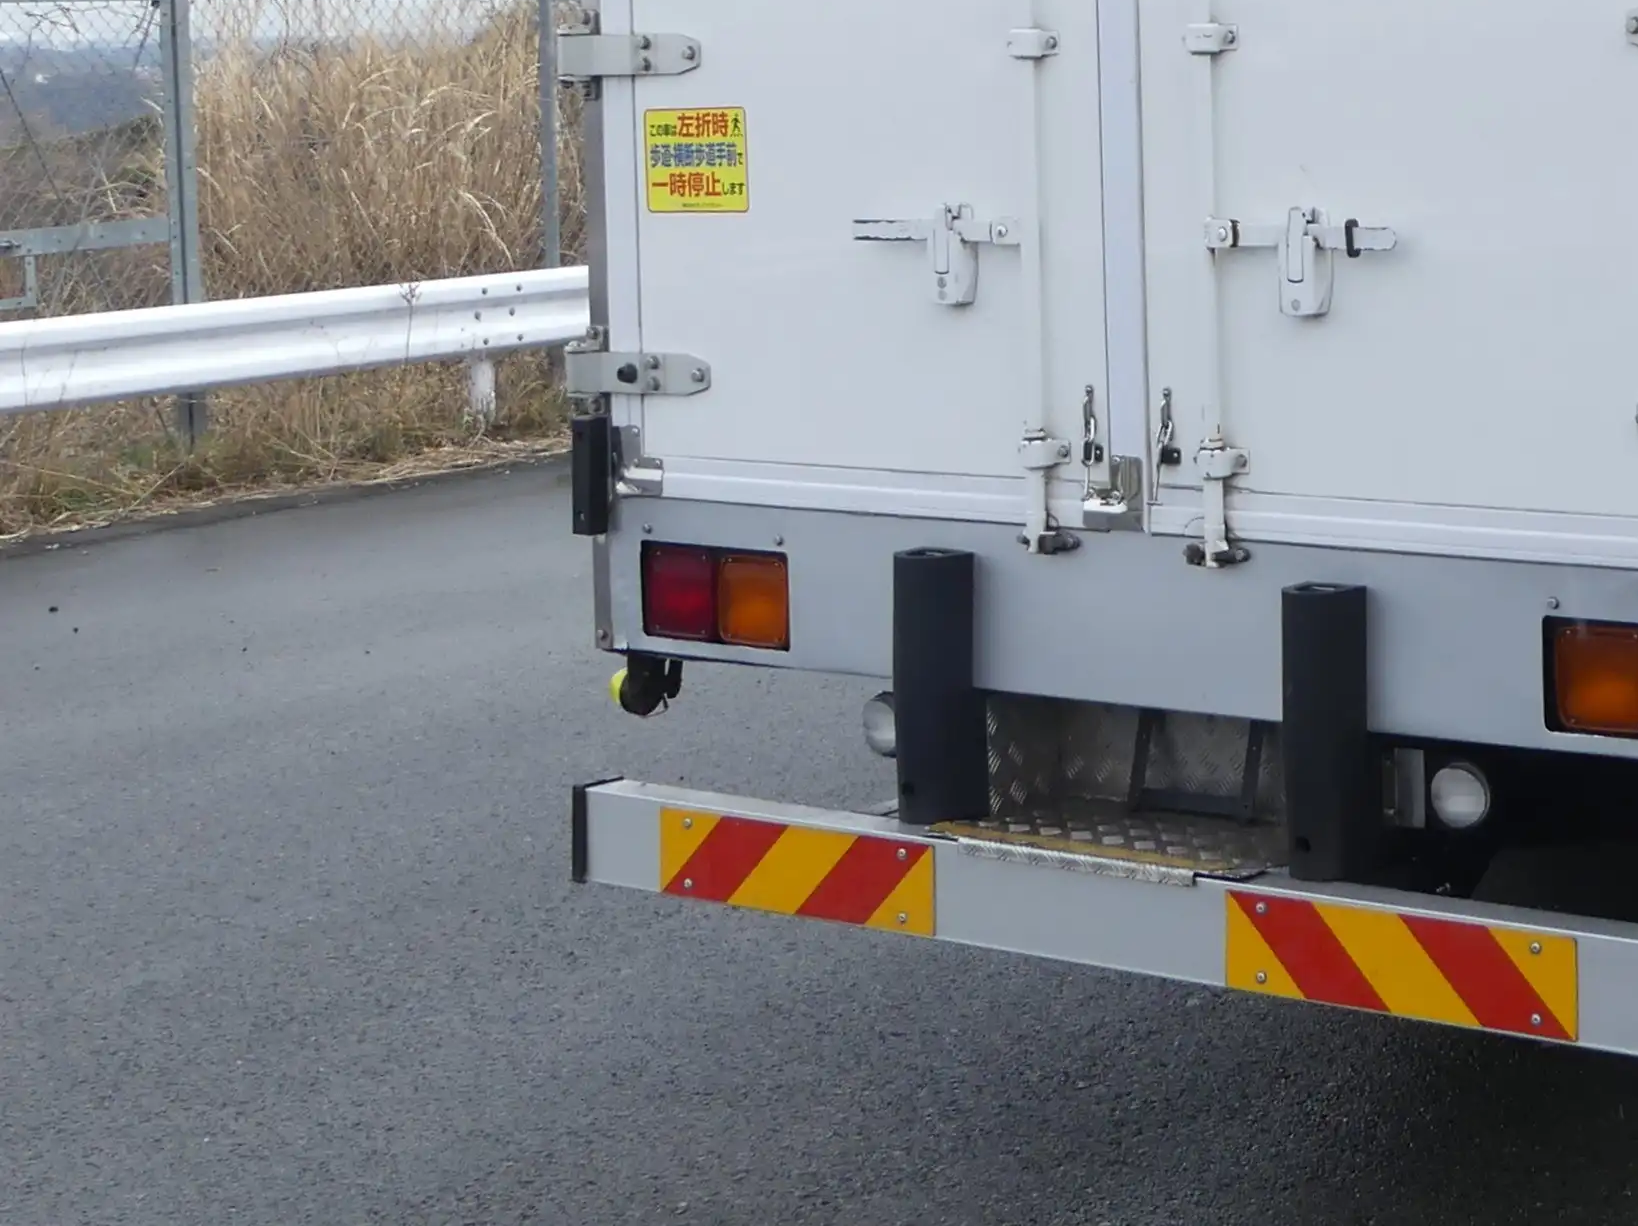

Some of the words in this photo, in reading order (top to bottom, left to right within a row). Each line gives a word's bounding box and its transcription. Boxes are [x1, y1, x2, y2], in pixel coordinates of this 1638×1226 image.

[652, 171, 745, 198] 一時停止します
